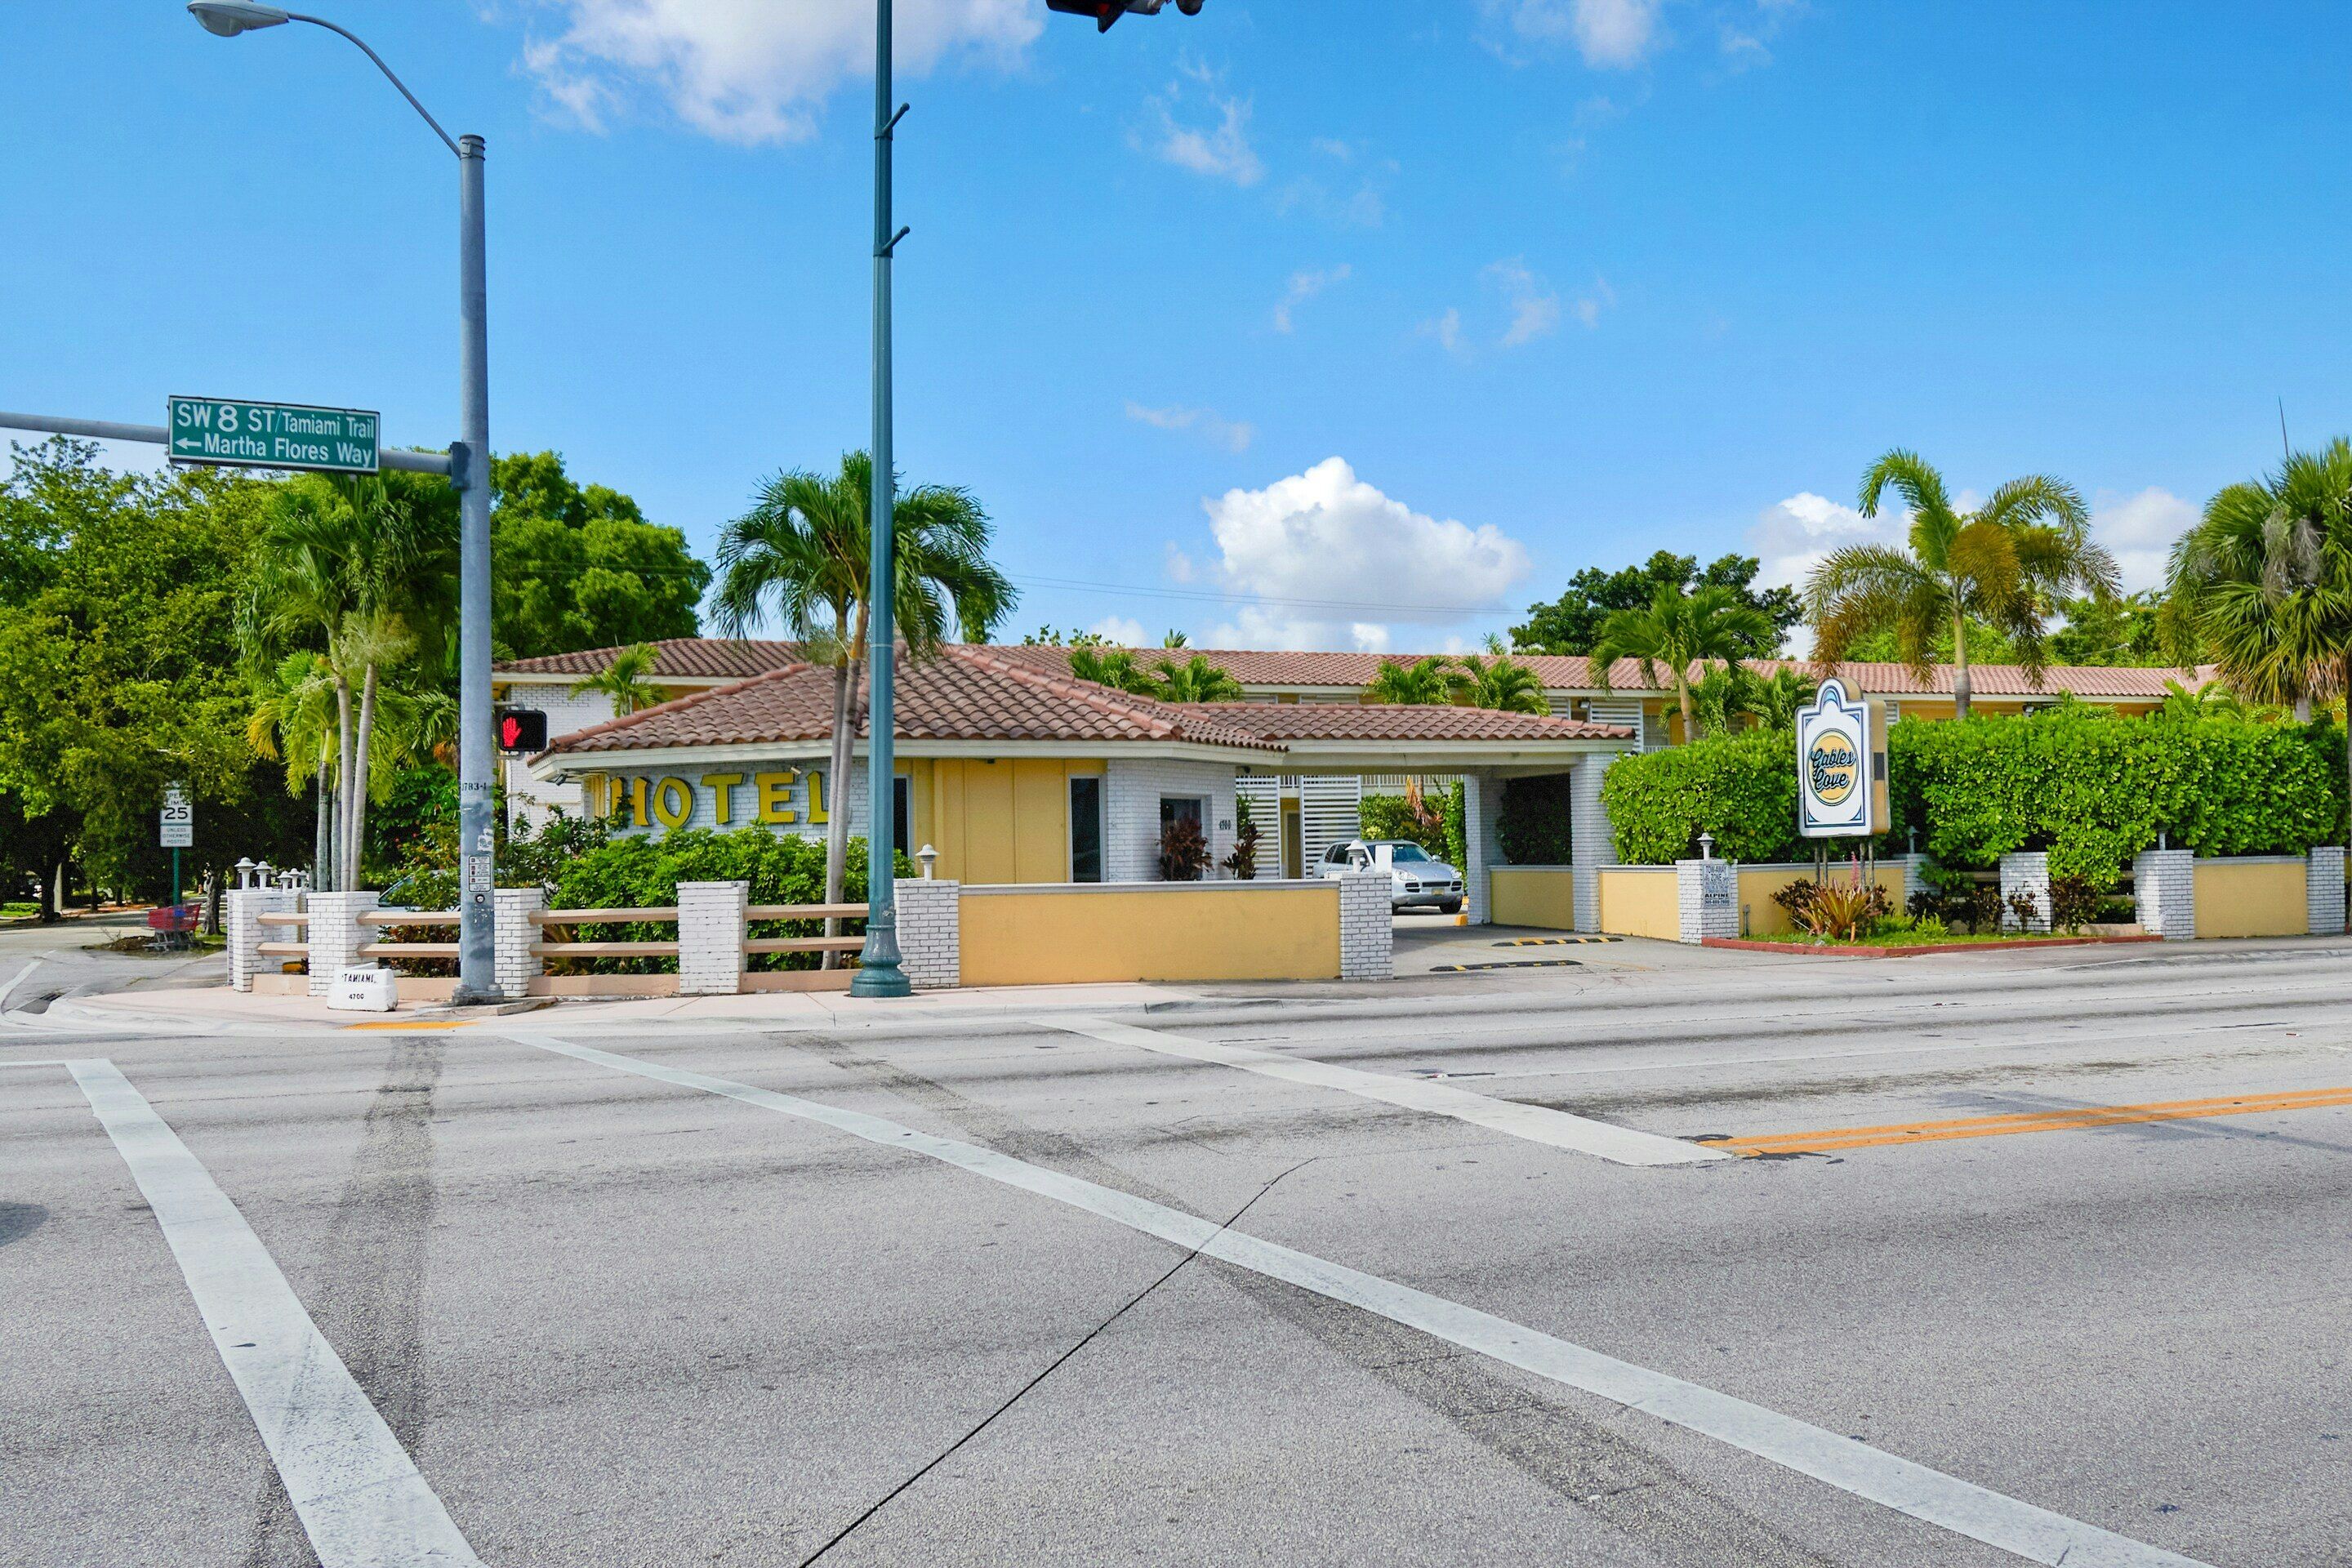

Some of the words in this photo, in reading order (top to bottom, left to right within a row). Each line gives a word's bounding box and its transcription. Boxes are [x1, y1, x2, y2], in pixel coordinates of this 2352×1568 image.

[176, 403, 212, 429] SW
[217, 405, 238, 432] 8
[345, 416, 374, 439] Trail
[204, 432, 267, 457] Martha
[274, 437, 328, 461] Flores
[336, 442, 372, 468] Way
[1810, 747, 1857, 768] Gables
[1812, 768, 1851, 792] Cove
[610, 770, 830, 829] HOTEL
[164, 807, 189, 820] 25
[343, 973, 374, 983] TAMIAMI
